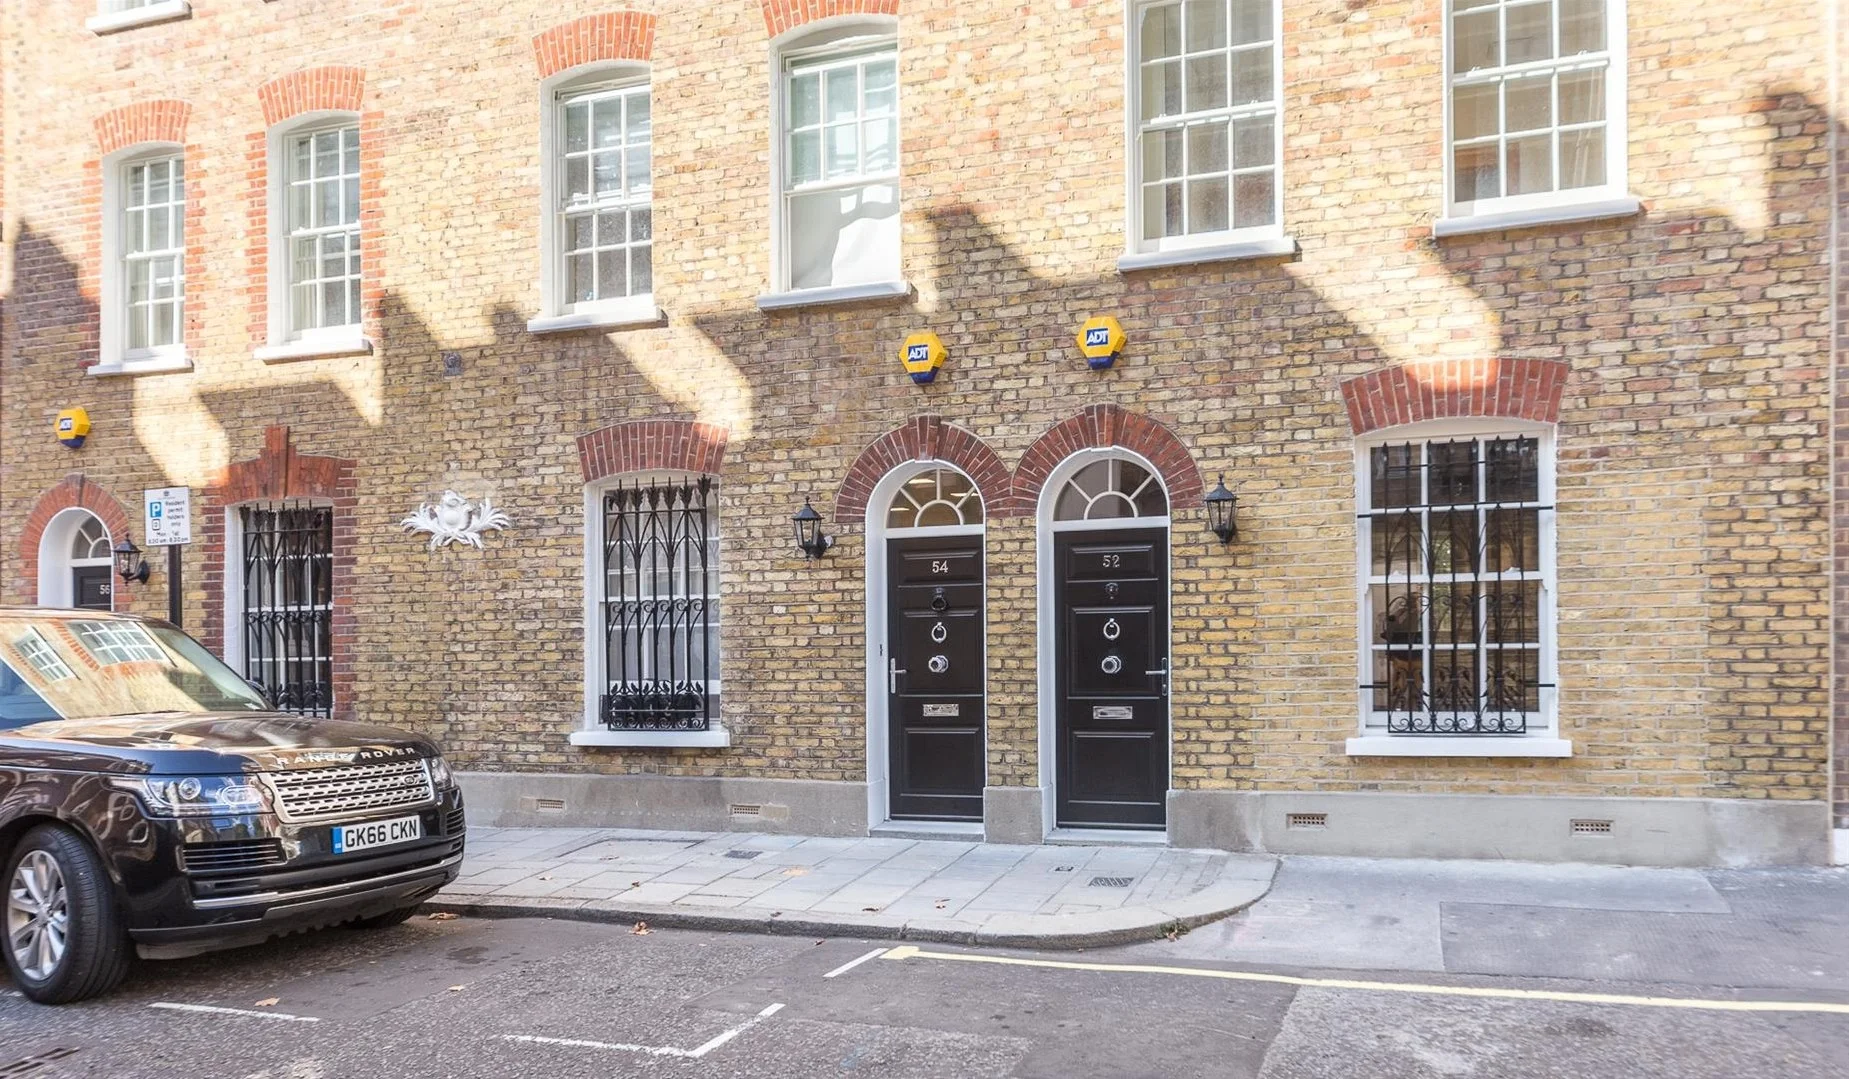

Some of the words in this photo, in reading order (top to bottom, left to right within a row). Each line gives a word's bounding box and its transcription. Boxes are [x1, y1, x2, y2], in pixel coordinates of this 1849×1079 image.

[1087, 330, 1107, 345] ADT
[909, 347, 928, 360] ADT
[932, 560, 948, 573] 54
[1103, 555, 1120, 568] 52
[100, 584, 110, 595] 56
[360, 747, 415, 759] ROVER
[345, 826, 387, 848] GK66
[391, 819, 417, 840] CKN
